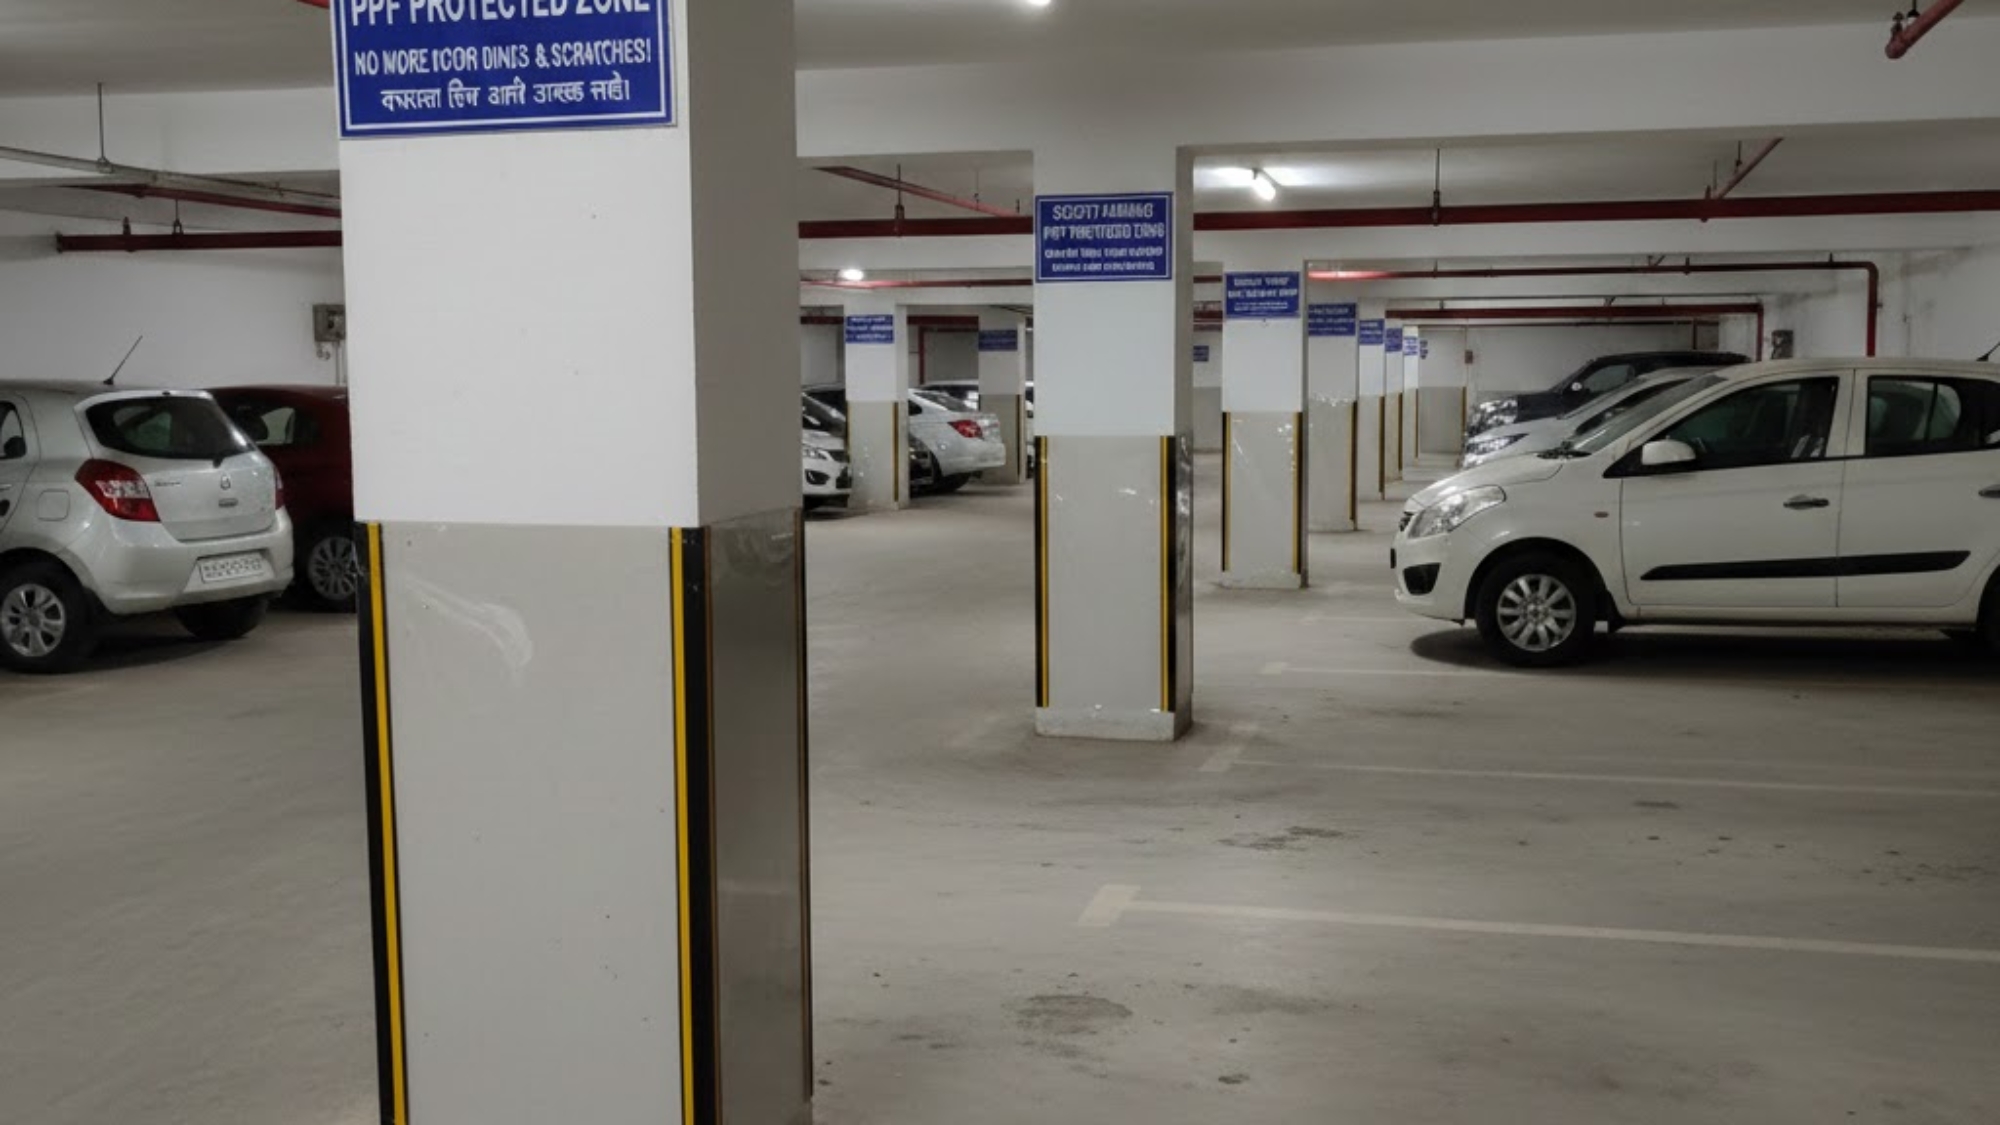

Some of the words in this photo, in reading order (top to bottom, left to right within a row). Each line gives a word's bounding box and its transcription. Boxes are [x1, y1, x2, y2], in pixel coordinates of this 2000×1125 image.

[351, 0, 401, 26] PPF
[354, 50, 379, 75] NO
[535, 43, 550, 68] &
